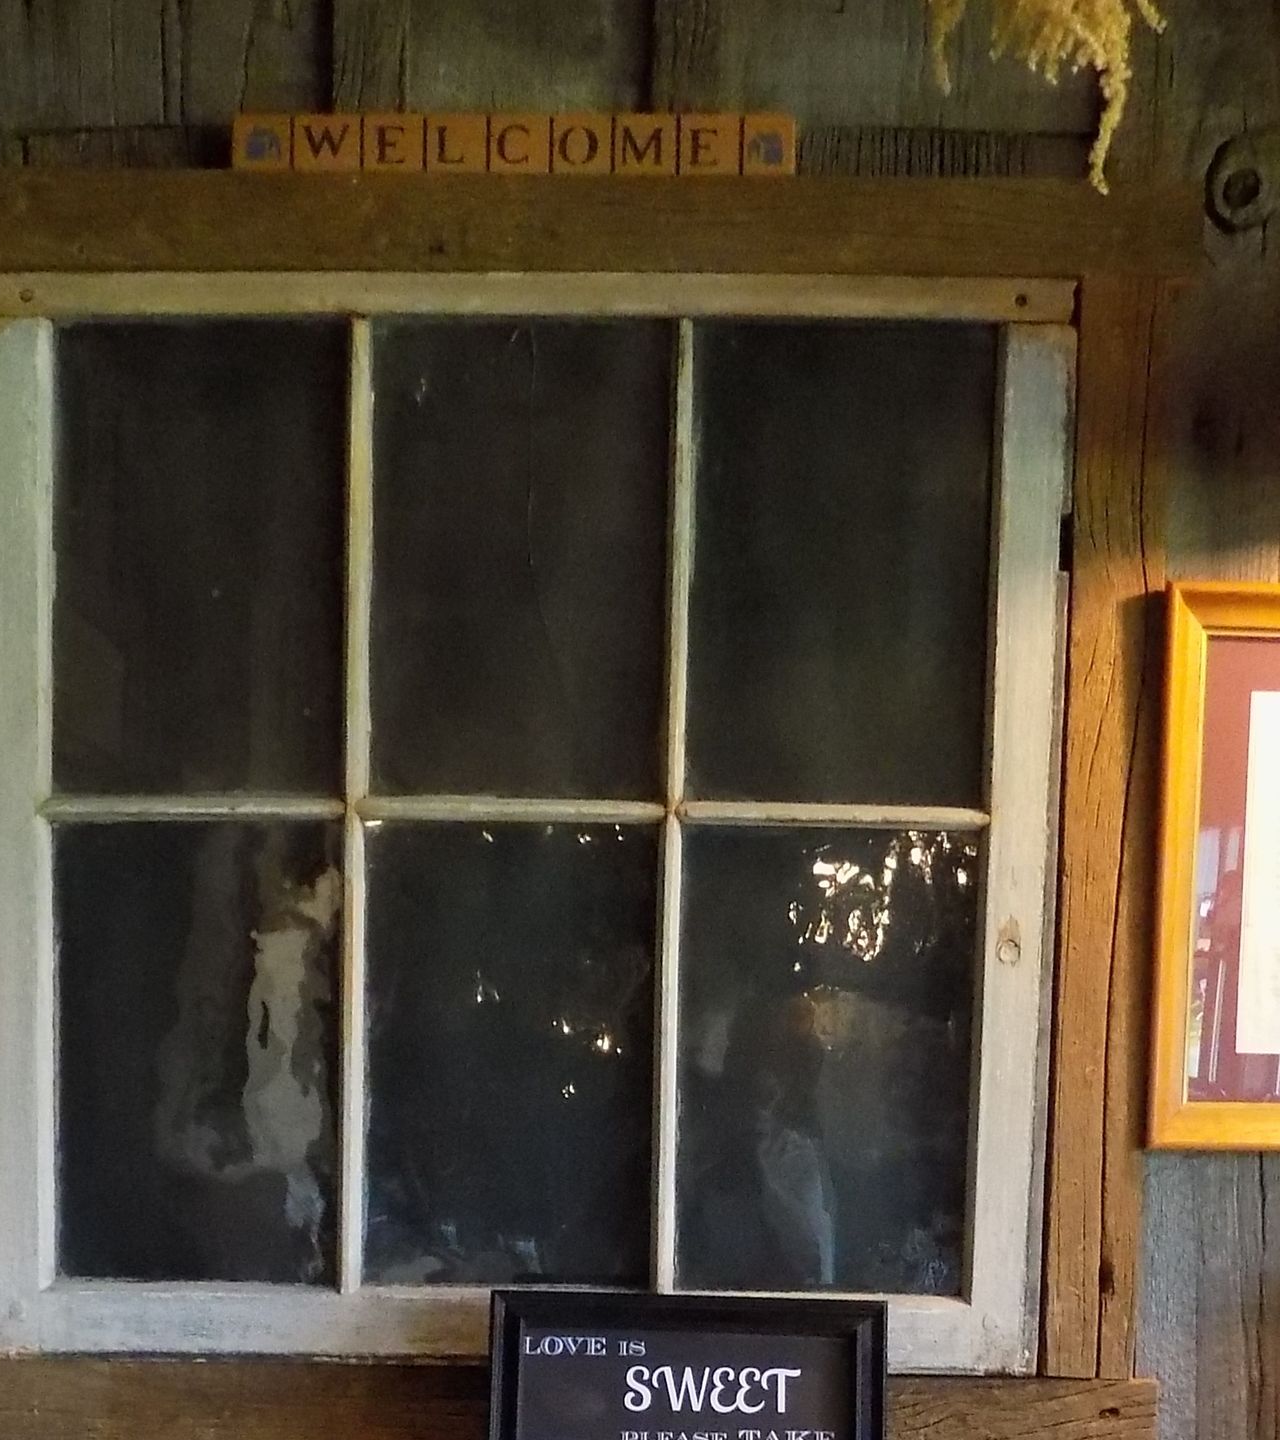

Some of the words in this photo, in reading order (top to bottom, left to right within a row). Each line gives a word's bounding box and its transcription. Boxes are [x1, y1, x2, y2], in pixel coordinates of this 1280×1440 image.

[303, 123, 719, 167] WELCOME
[524, 1335, 608, 1356] LOVE
[618, 1340, 647, 1357] IS
[623, 1365, 802, 1414] SWEET
